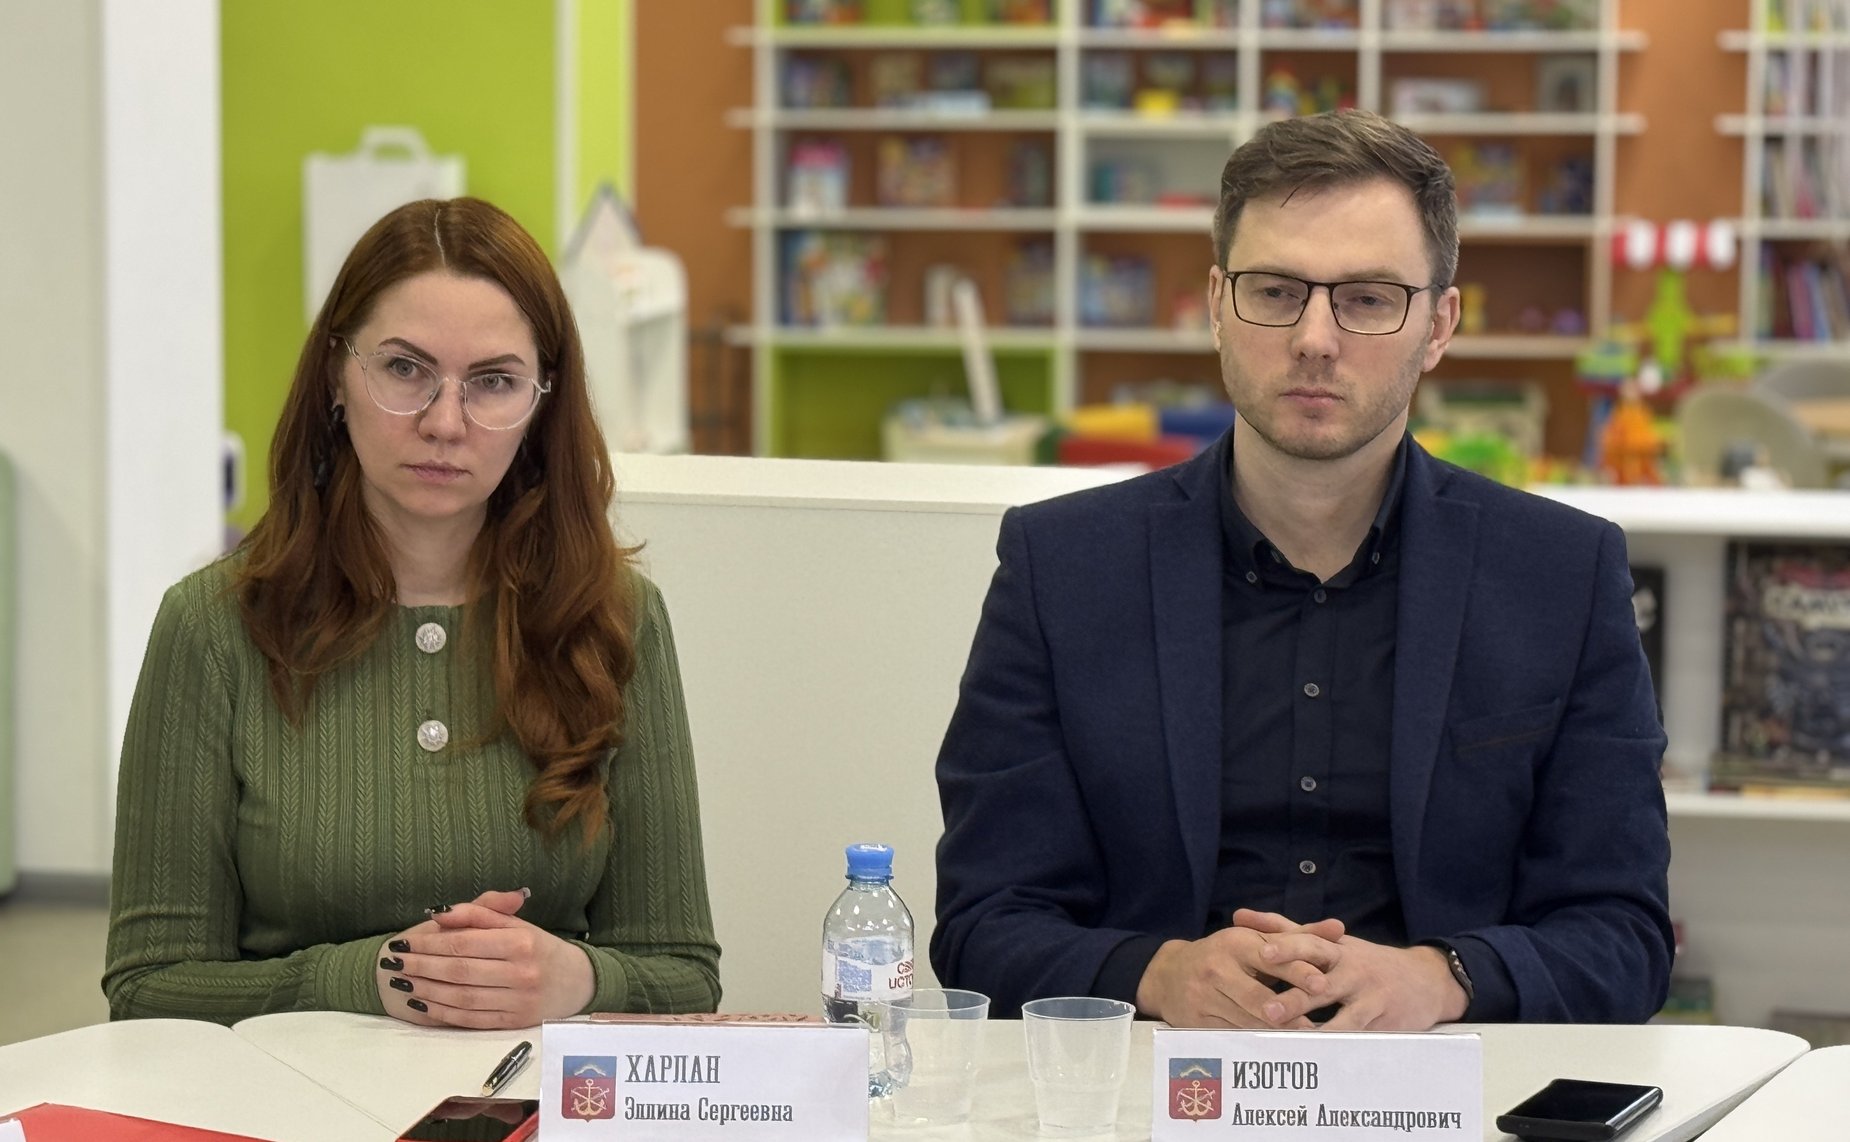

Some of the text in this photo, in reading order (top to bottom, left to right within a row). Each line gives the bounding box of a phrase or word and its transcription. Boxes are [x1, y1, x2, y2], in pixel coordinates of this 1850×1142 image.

[625, 1054, 721, 1084] ХАРЛАН
[1231, 1061, 1319, 1090] ИЗОТОВ
[624, 1096, 793, 1126] Эллина Сергеевна
[1231, 1102, 1462, 1133] Алексей Александрович
